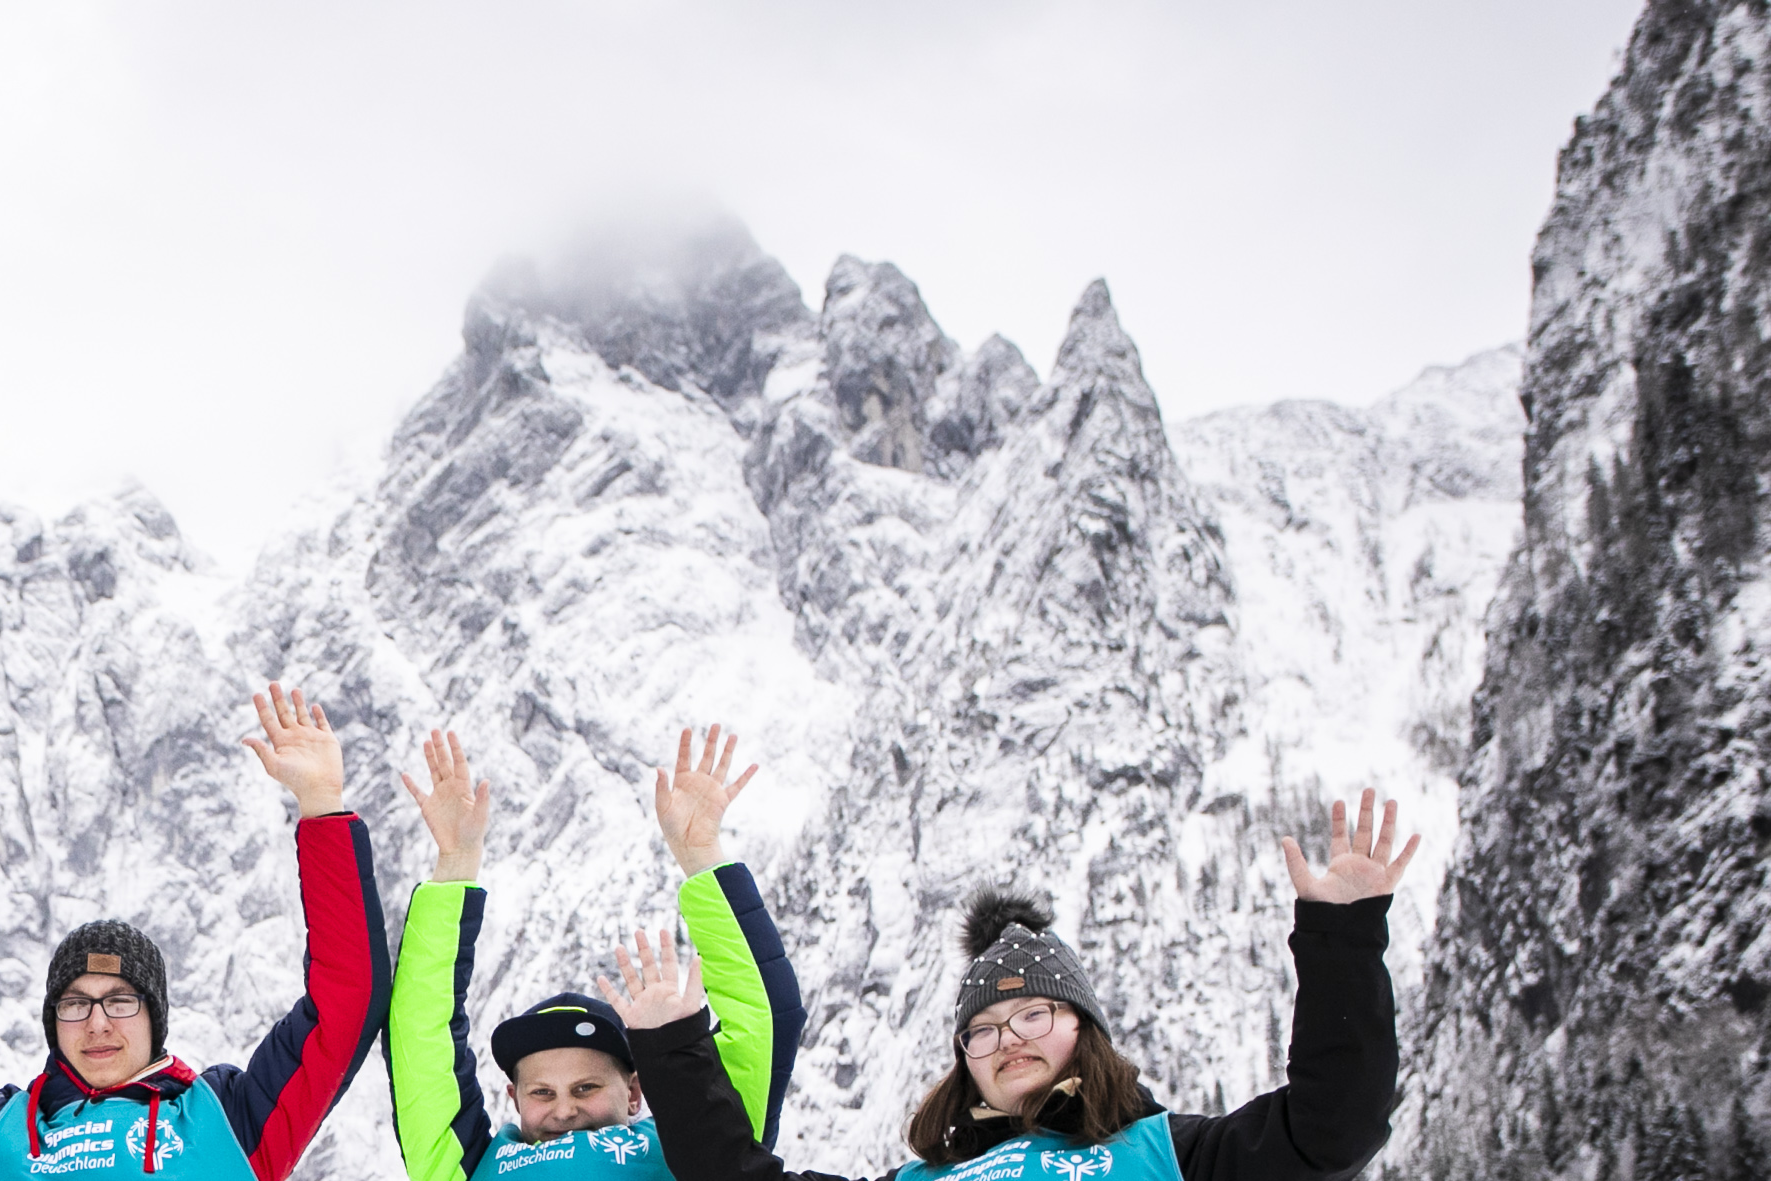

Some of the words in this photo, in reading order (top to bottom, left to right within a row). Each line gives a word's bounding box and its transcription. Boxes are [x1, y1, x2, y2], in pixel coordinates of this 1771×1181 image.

[44, 1119, 113, 1148] Special
[30, 1153, 116, 1174] Deutschland
[498, 1146, 576, 1174] Deutschland
